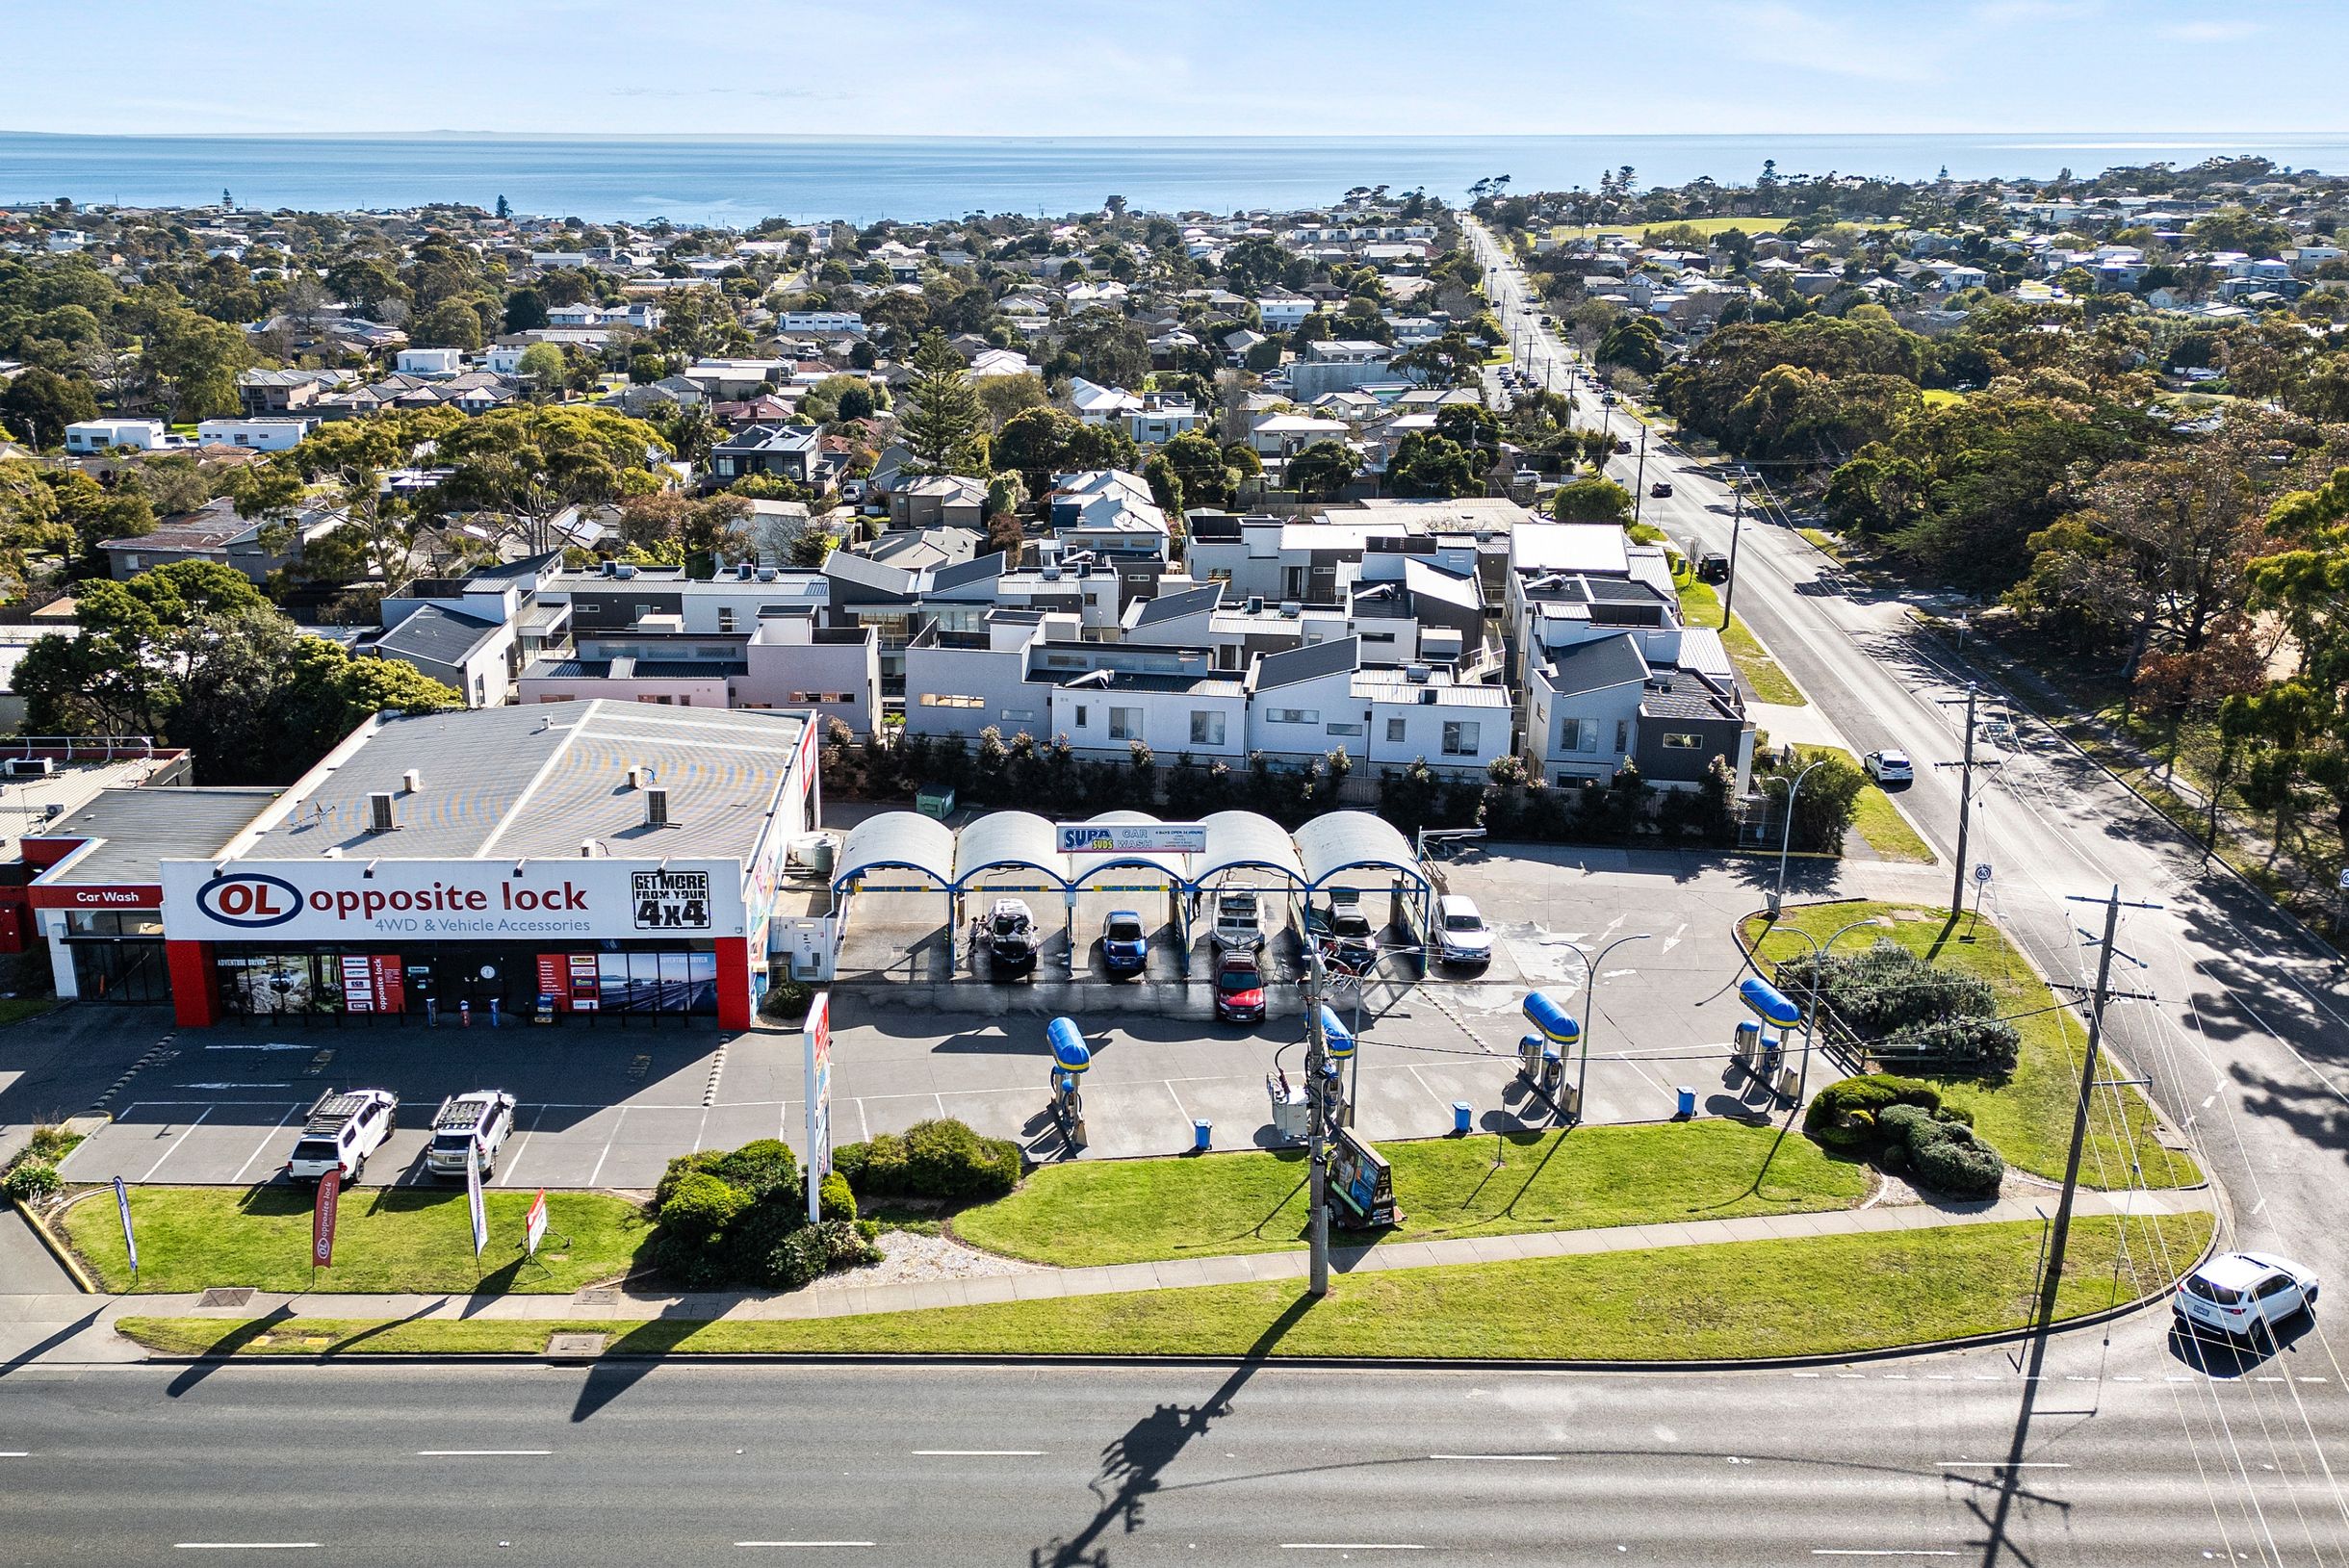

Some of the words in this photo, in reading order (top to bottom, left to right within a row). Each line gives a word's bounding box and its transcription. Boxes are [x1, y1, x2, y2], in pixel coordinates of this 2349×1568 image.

[1064, 829, 1112, 848] SUPA
[1122, 829, 1148, 838] CAR
[1093, 839, 1113, 850] SUDS
[1117, 839, 1152, 849] WASH
[635, 875, 658, 890] GET
[660, 875, 706, 890] MORE
[77, 892, 100, 902] Car
[102, 892, 139, 902] Wash
[218, 884, 281, 915] OL
[309, 882, 488, 920] opposite
[502, 881, 589, 911] lock
[636, 890, 670, 900] FROM
[672, 890, 706, 899] YOUR
[375, 919, 418, 932] 4WD
[425, 919, 436, 932] &
[439, 918, 494, 932] Vehicle
[498, 918, 591, 932] Accessories
[374, 958, 383, 974] lock
[376, 977, 387, 1010] opposite
[322, 1201, 330, 1237] opposite
